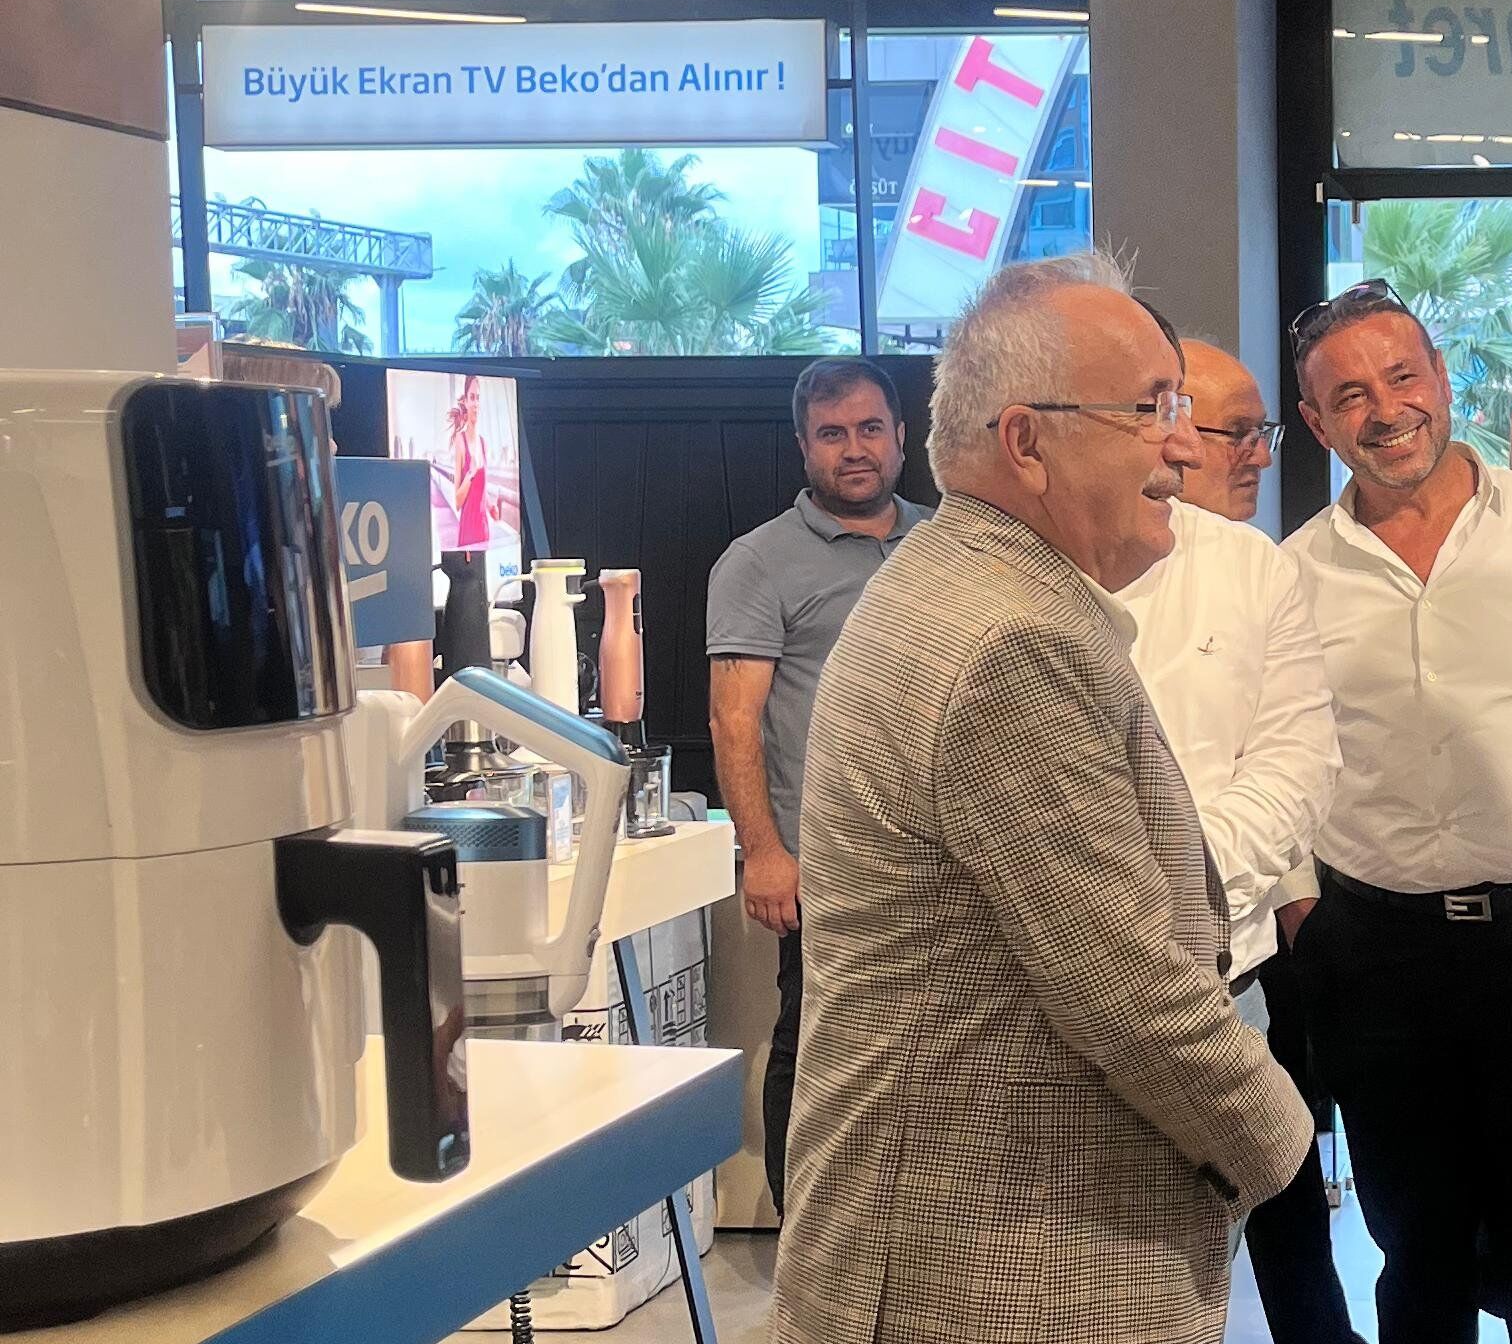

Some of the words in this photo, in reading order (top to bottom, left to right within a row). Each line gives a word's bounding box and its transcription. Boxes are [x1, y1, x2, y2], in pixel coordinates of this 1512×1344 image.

[243, 66, 350, 103] Büyük
[358, 65, 451, 94] Ekran
[460, 65, 506, 94] TV
[516, 63, 669, 93] Beko'dan
[678, 62, 769, 92] Alınır
[340, 500, 390, 566] ko
